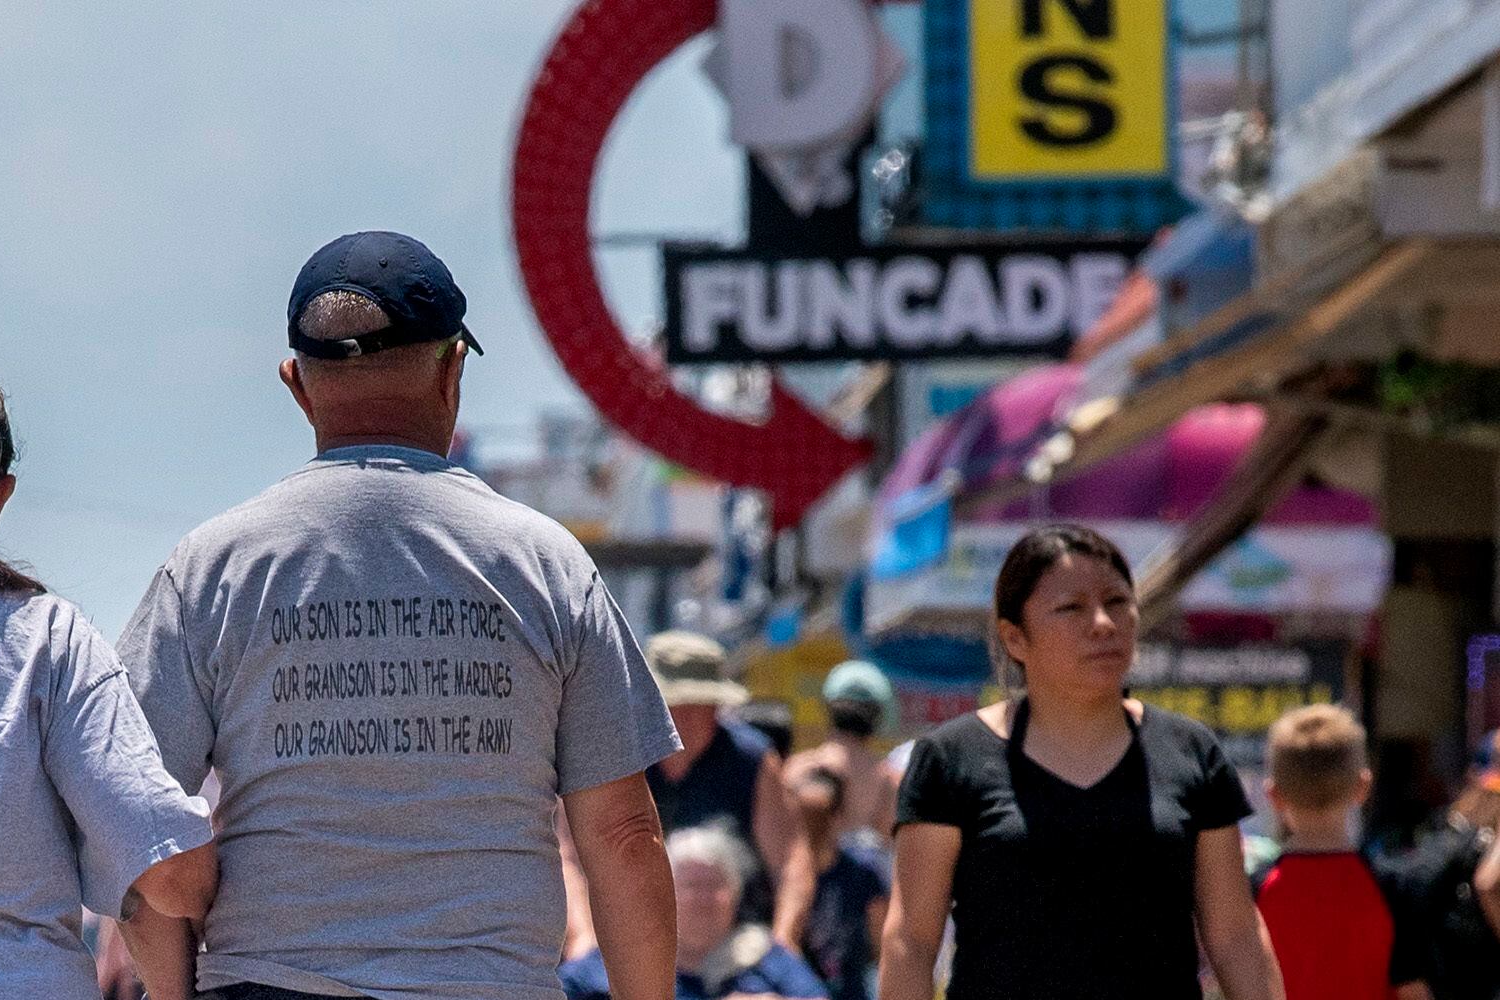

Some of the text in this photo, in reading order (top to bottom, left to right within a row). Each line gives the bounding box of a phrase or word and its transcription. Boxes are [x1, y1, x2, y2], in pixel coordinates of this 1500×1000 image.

[272, 597, 506, 645] OUR SON IS IN THE AIR FORCE
[273, 658, 512, 703] OUR GRANDSON IS IN THE MARINES
[274, 715, 513, 758] OUR GRANDSON IS IN THE ARMY
